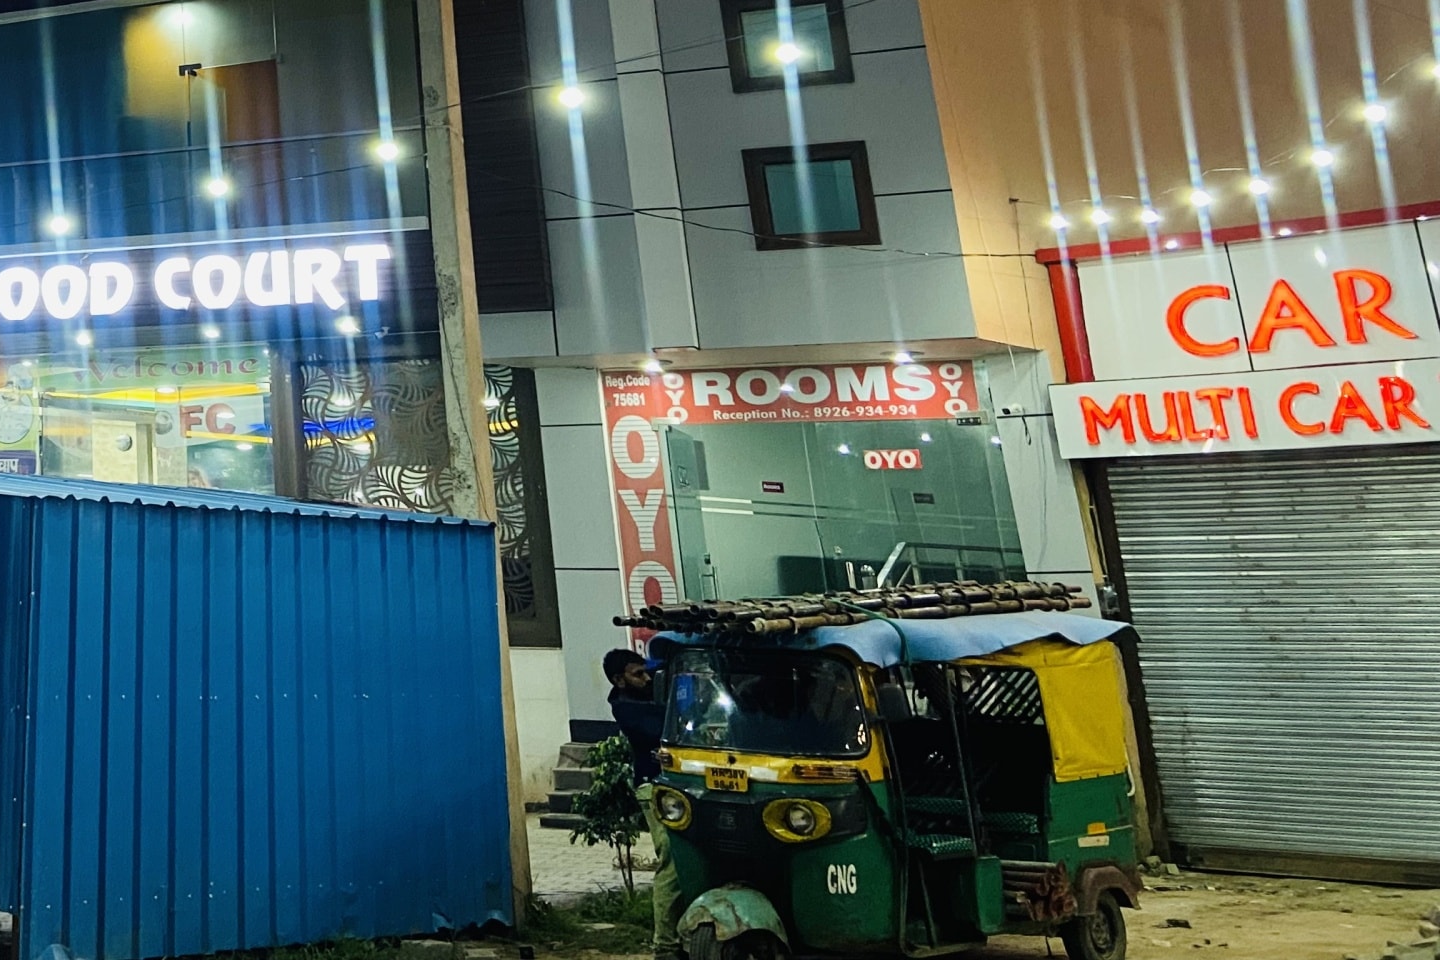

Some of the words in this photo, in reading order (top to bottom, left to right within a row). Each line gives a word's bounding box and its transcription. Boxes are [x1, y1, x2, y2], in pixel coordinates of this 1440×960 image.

[155, 243, 391, 311] COURT
[1166, 268, 1419, 358] CAR
[73, 355, 258, 384] Welcome
[691, 363, 936, 406] ROOMS
[938, 363, 969, 415] OYO
[613, 392, 646, 407] 75681
[663, 372, 689, 423] OYO
[713, 408, 777, 422] Reception
[814, 405, 917, 418] 8926-934-934
[1079, 386, 1259, 446] MULTI
[1277, 376, 1431, 436] CAR
[179, 403, 236, 438] FC
[864, 450, 918, 470] OYO
[611, 415, 678, 617] OYO
[827, 863, 857, 894] CNG
